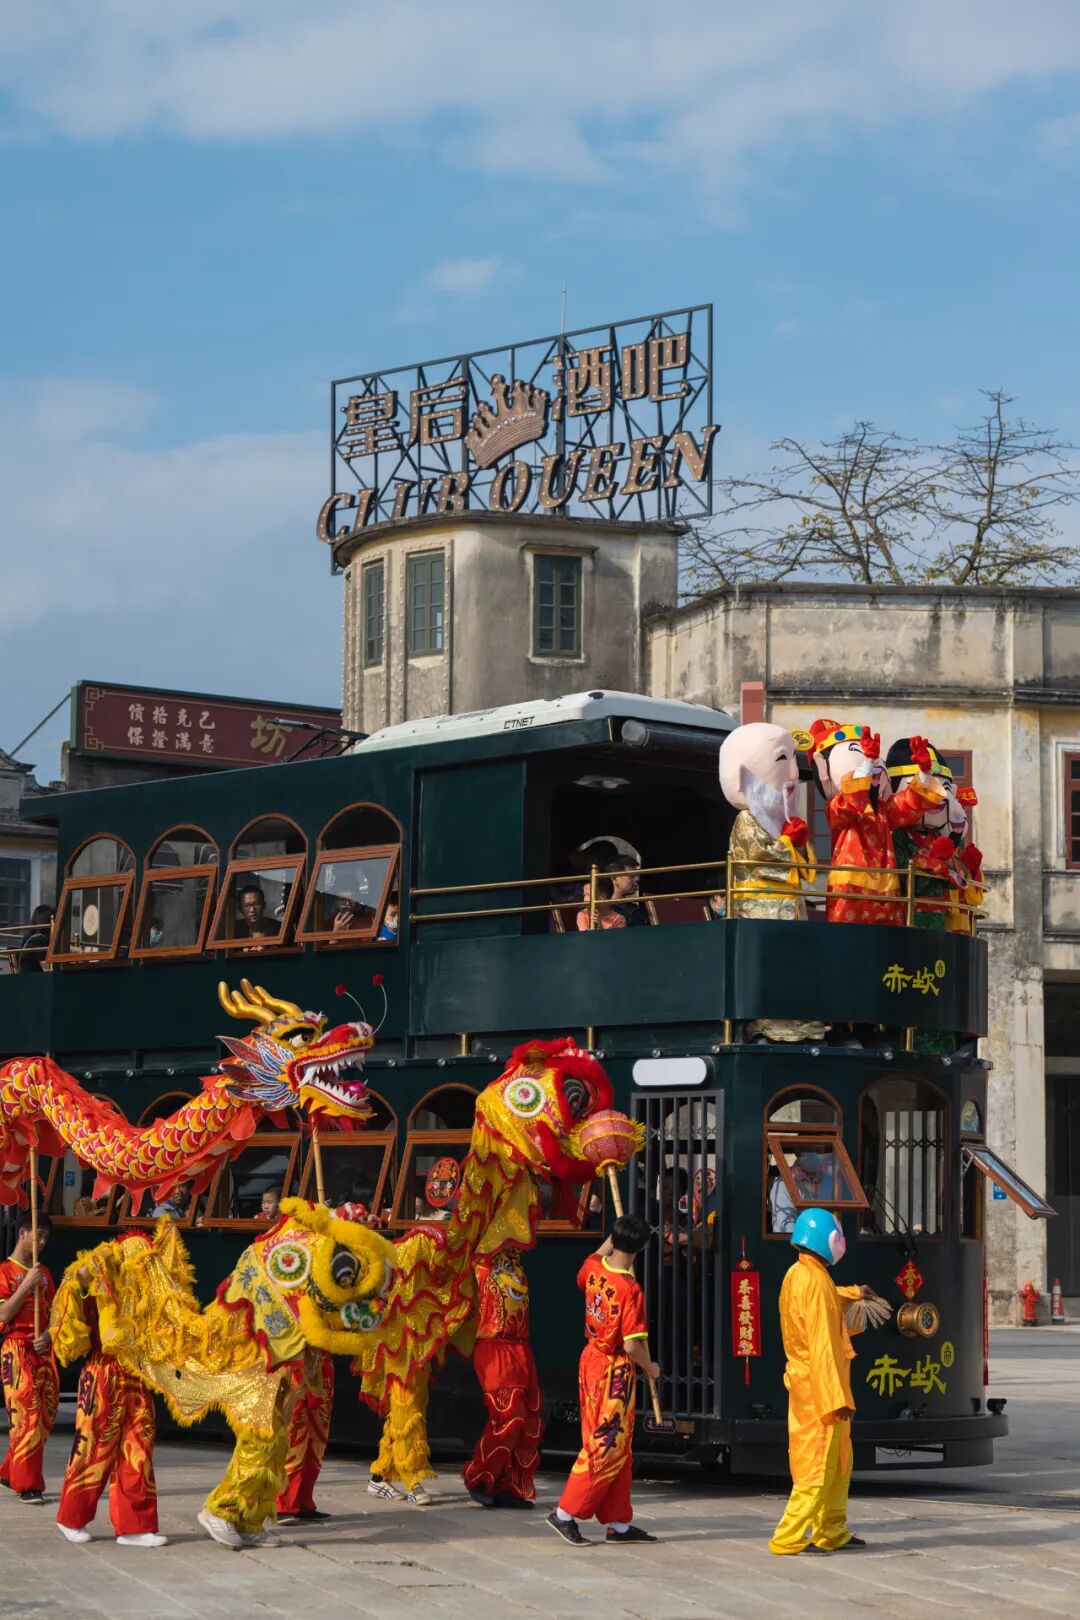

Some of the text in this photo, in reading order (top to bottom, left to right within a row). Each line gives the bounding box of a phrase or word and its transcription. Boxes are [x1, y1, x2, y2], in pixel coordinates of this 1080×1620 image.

[488, 423, 722, 513] QUEEN
[503, 716, 536, 730] CTNET
[882, 963, 940, 997] 赤坎
[865, 1353, 948, 1398] 赤坎
